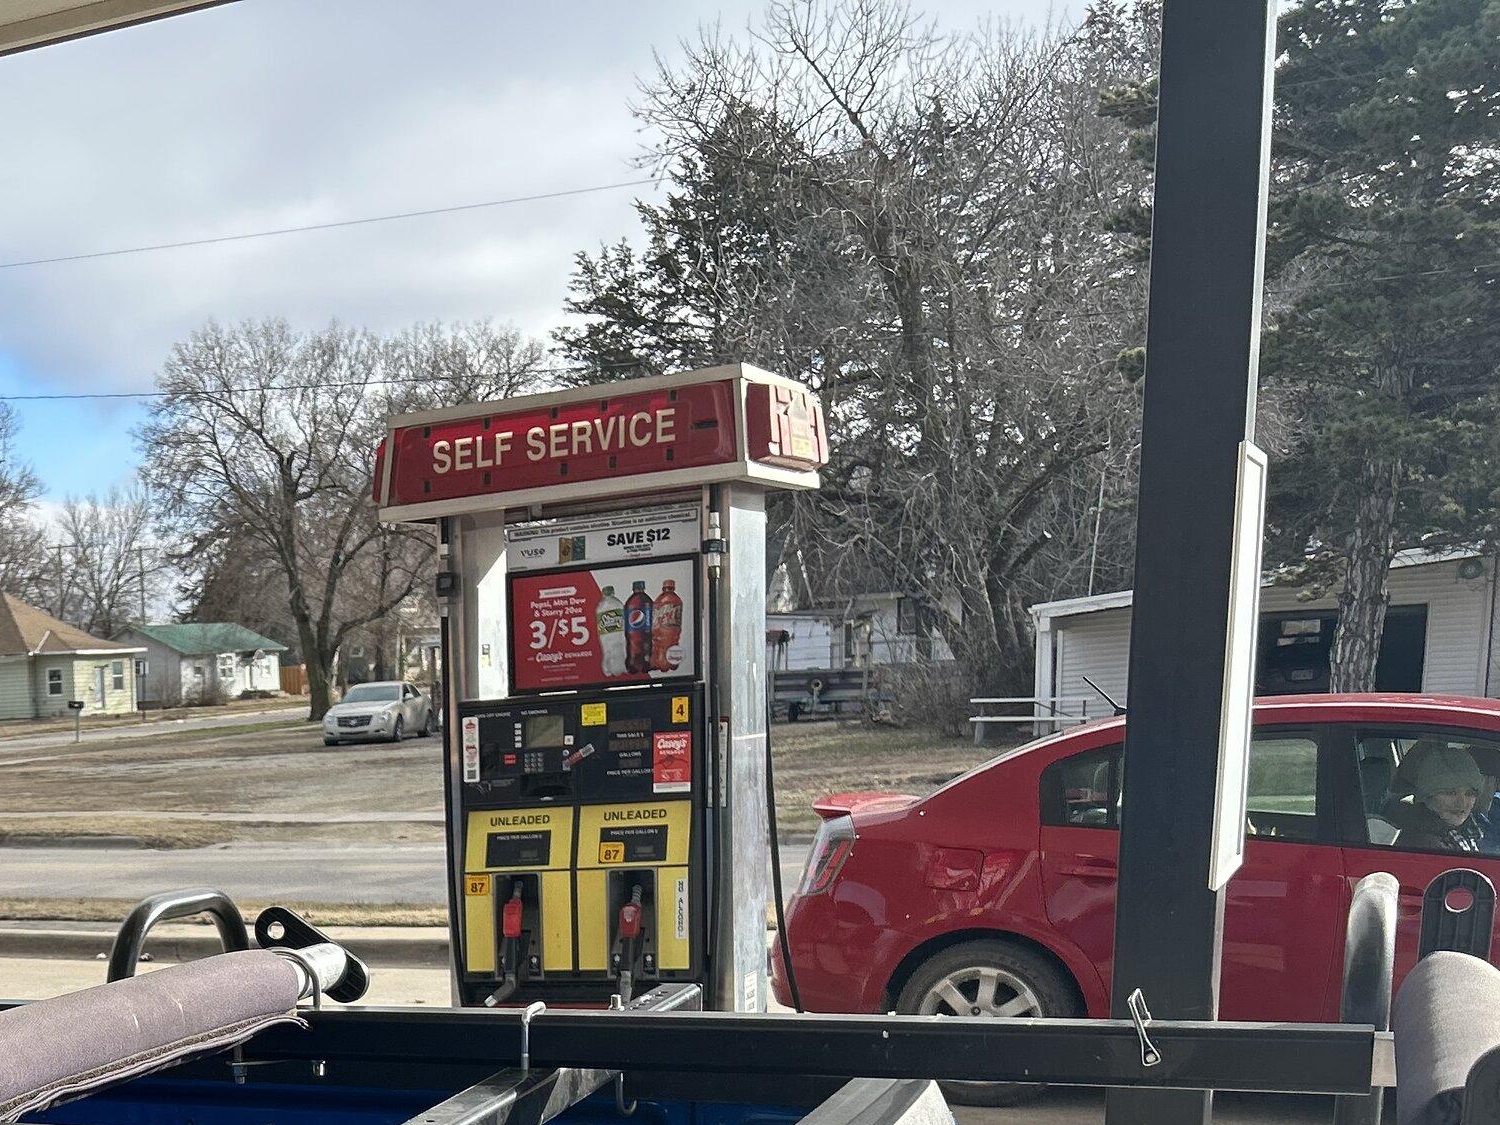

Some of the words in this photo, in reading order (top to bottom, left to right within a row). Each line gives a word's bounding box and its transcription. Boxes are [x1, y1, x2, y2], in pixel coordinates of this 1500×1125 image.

[432, 431, 514, 475] SELF
[526, 408, 676, 462] SERVICE
[606, 531, 644, 546] SAVE
[646, 528, 670, 542] $12
[529, 616, 590, 649] 3/$5
[675, 703, 685, 717] 4
[490, 814, 550, 827] UNLEADED
[603, 809, 667, 821] UNLEADED
[604, 849, 619, 860] 87
[470, 882, 485, 893] 87
